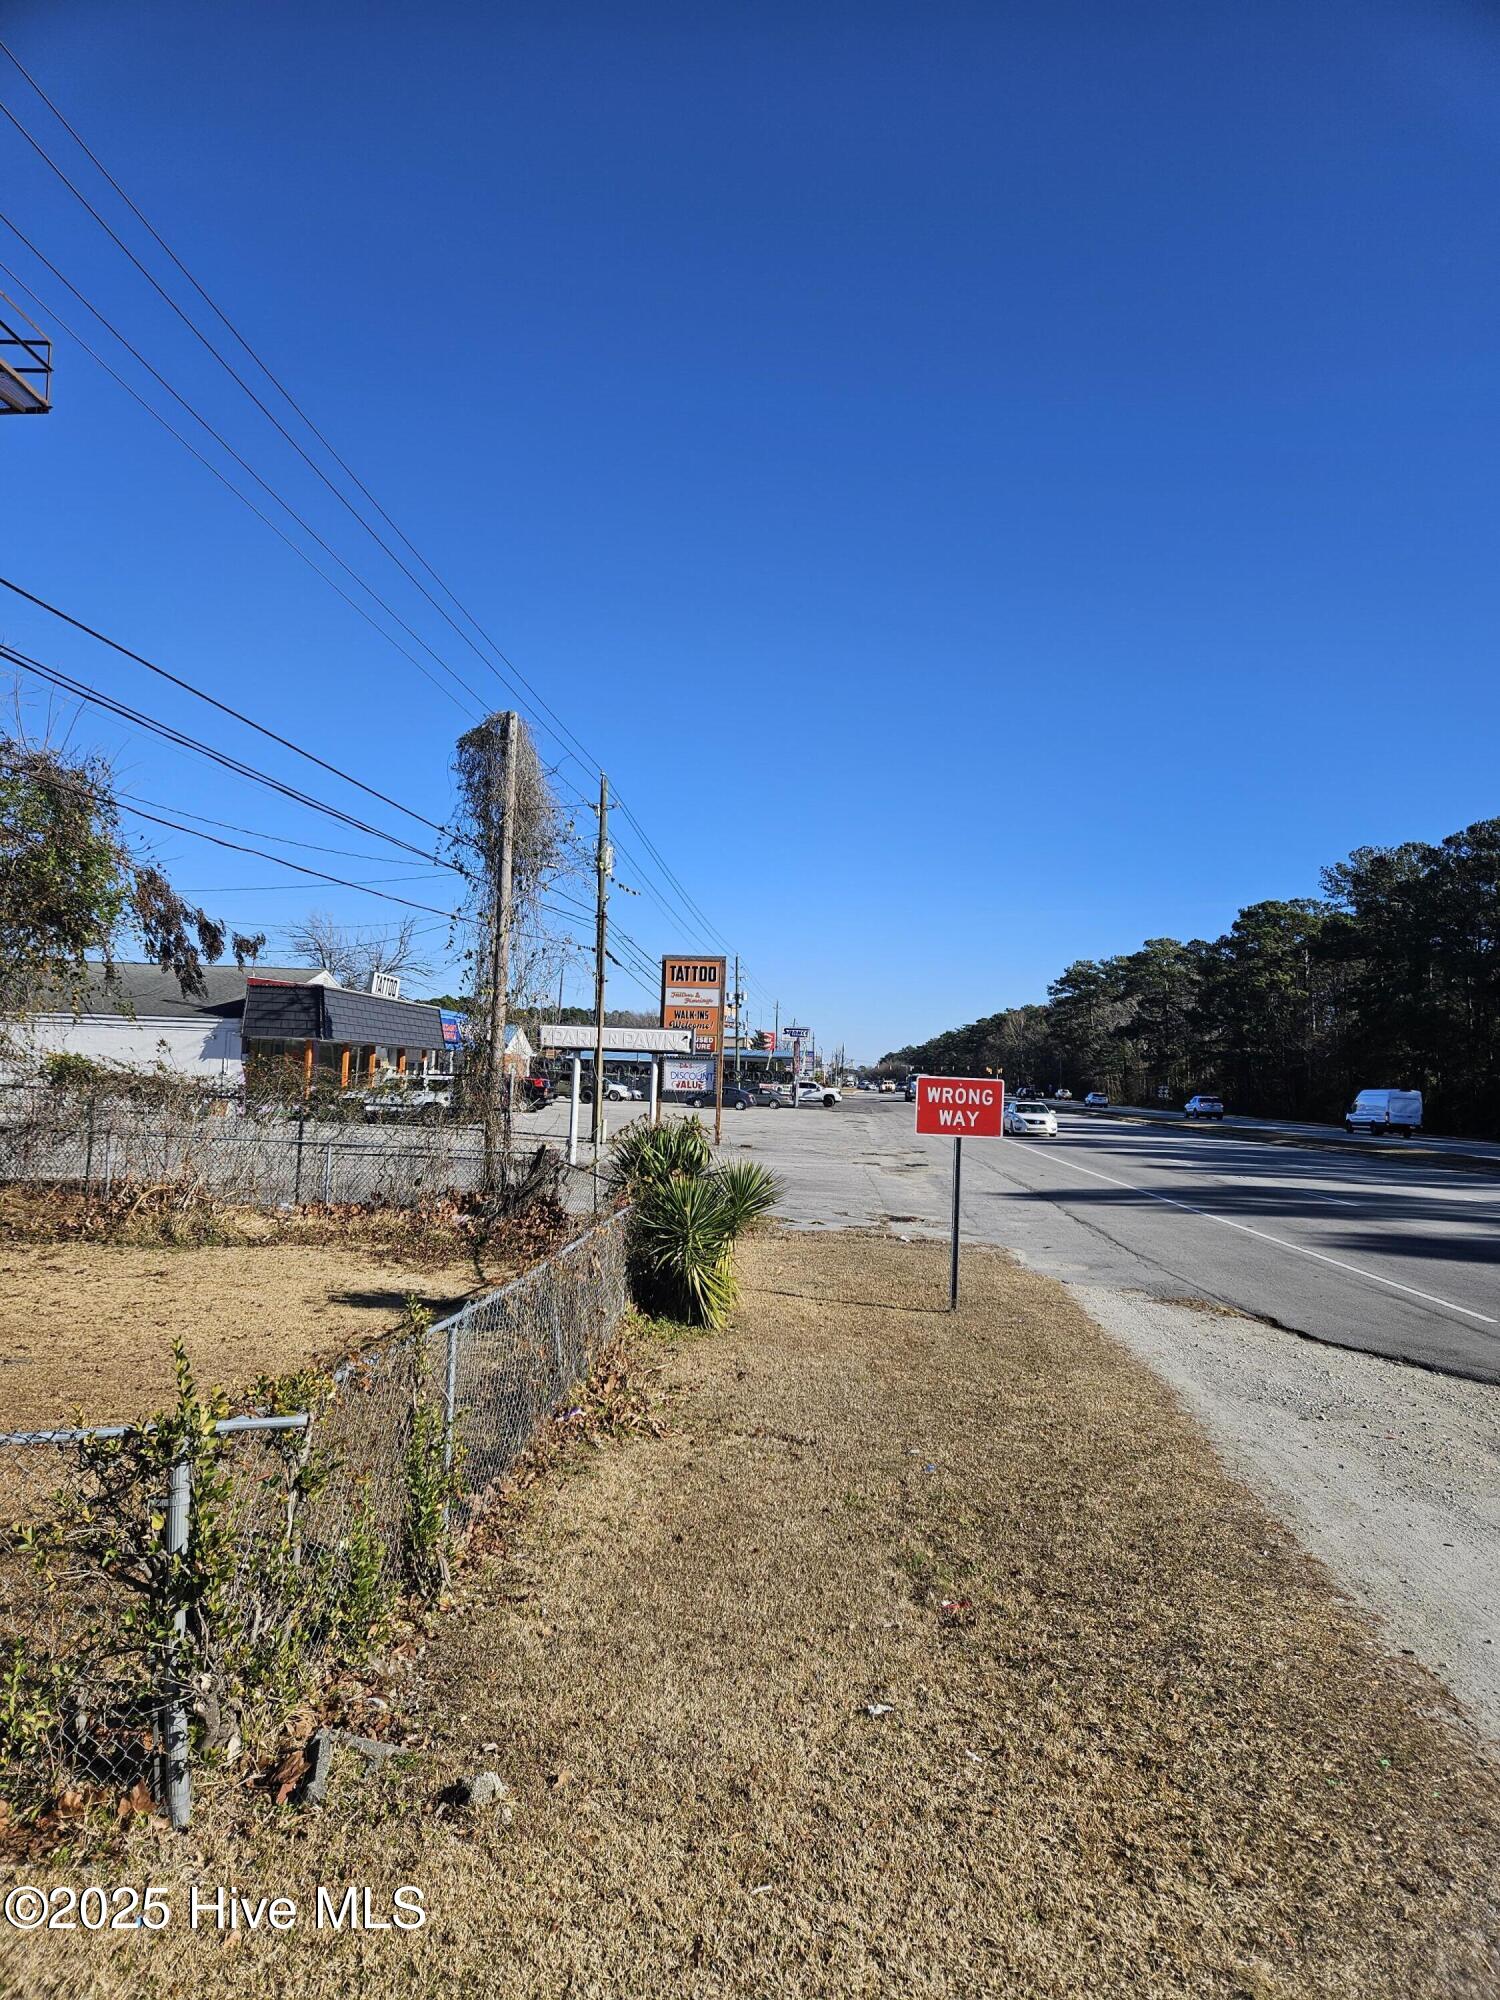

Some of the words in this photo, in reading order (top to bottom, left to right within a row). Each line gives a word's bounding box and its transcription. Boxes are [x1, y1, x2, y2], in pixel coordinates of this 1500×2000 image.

[670, 966, 717, 982] TATTOO
[374, 974, 398, 997] TATTOO
[674, 1010, 709, 1020] WALK-INS
[608, 1032, 619, 1046] N
[671, 1071, 714, 1081] DISCOUNT
[675, 1081, 704, 1089] VALUE
[927, 1086, 994, 1106] WRONG
[939, 1109, 980, 1127] WAY
